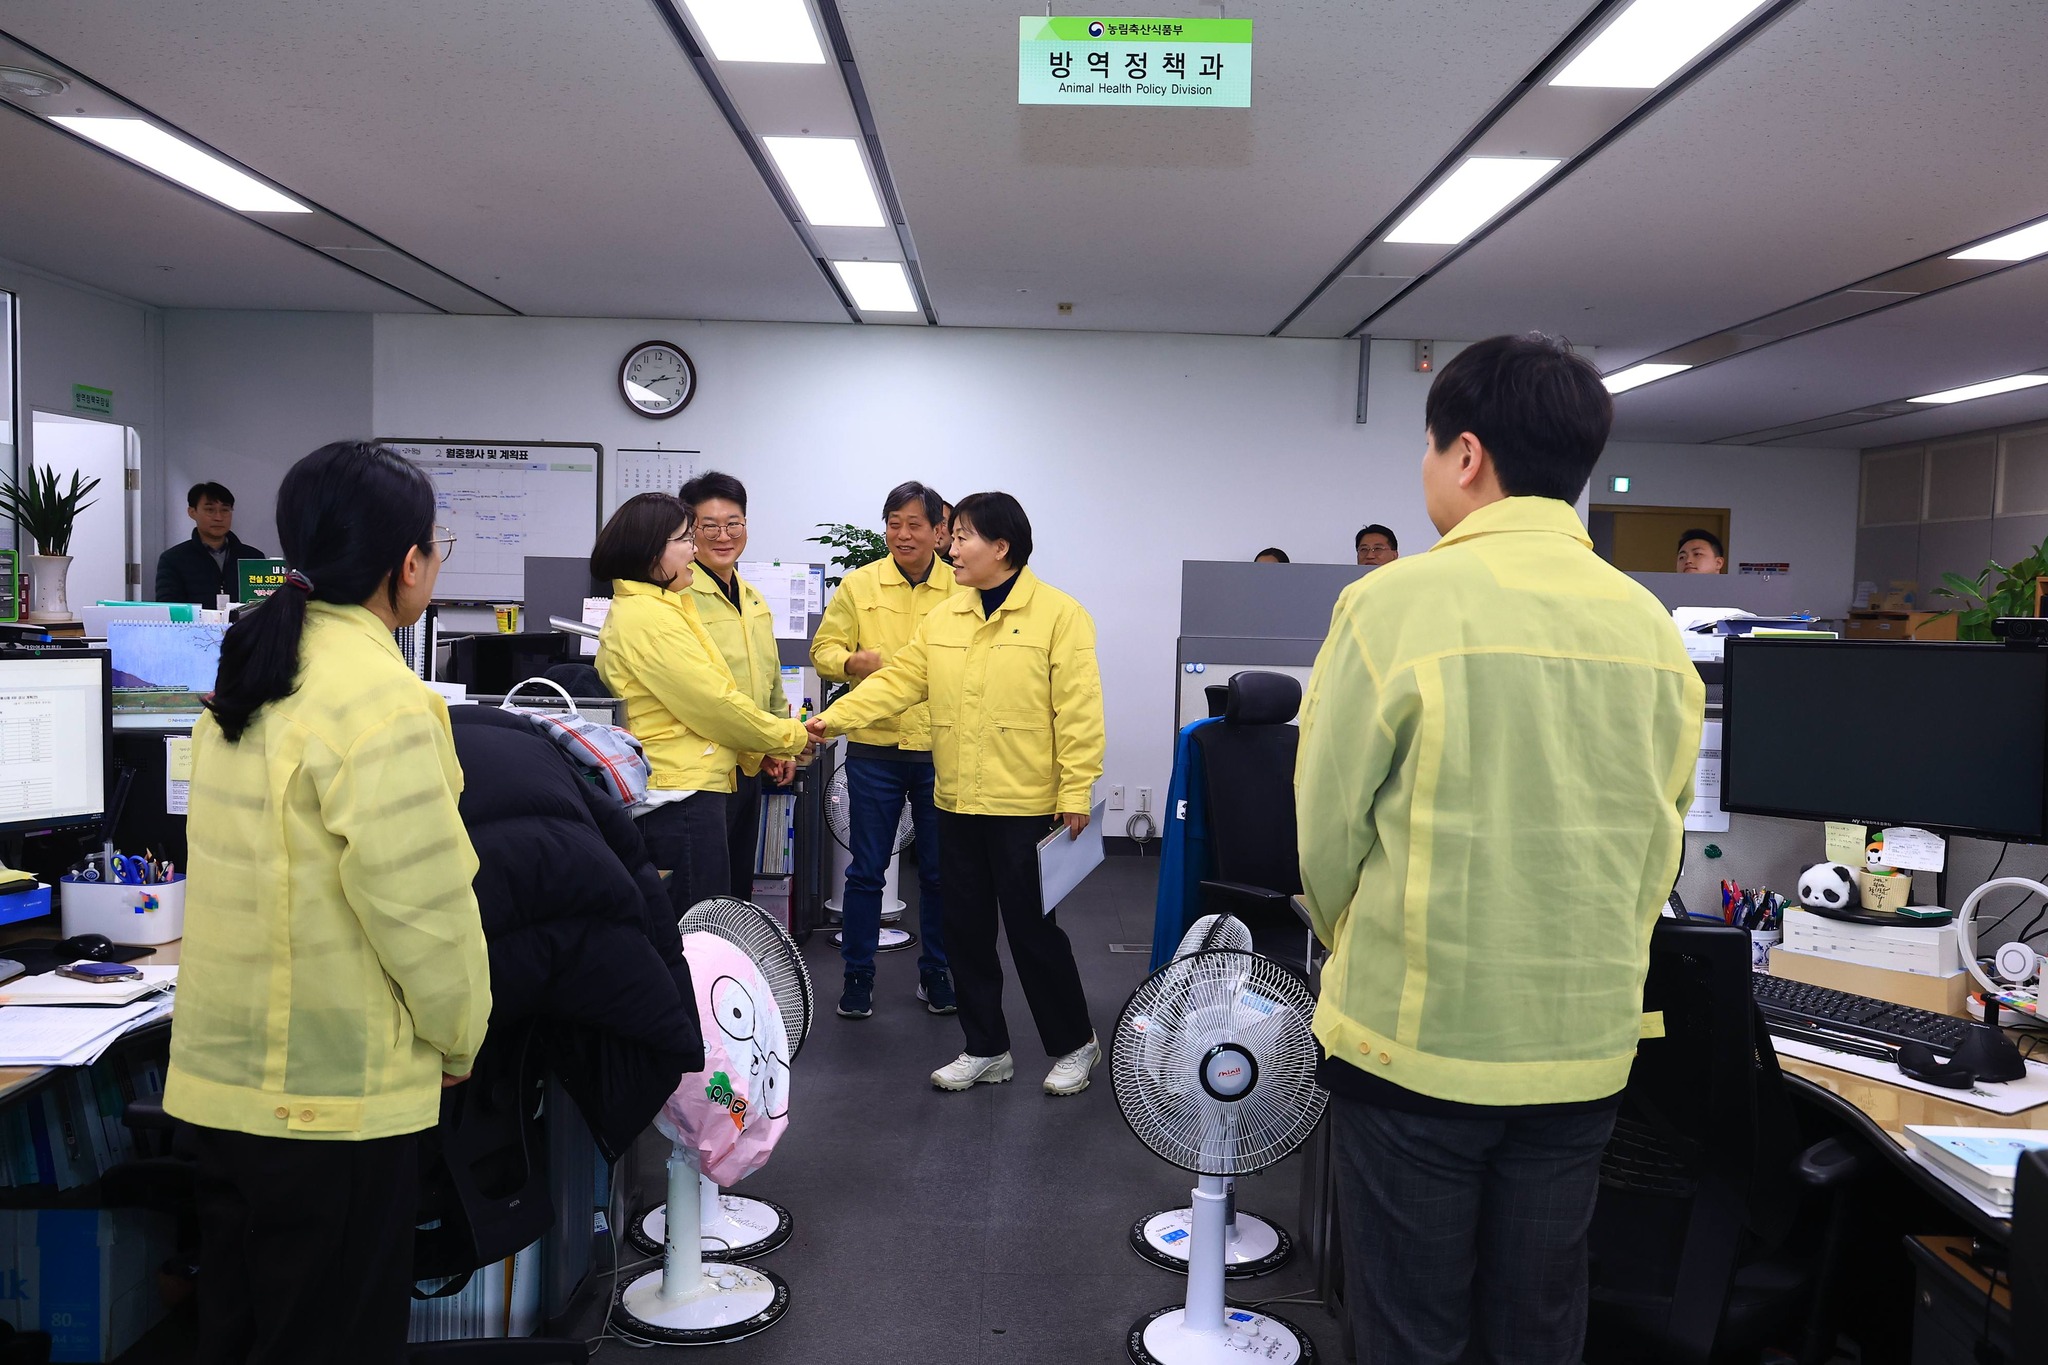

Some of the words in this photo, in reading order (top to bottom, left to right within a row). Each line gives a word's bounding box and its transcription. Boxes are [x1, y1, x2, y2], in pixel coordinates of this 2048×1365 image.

[1107, 23, 1184, 36] 농림축산식품부
[1058, 82, 1094, 93] Animal
[1098, 83, 1131, 94] Health
[1136, 83, 1167, 96] Policy
[1171, 84, 1212, 95] Division
[643, 356, 649, 364] 11
[655, 352, 663, 360] 12
[676, 364, 681, 372] 2
[679, 376, 685, 385] 3
[445, 448, 485, 459] 월중행사
[486, 449, 497, 460] 및
[499, 450, 529, 460] 계획표
[272, 566, 280, 574] 내
[51, 1312, 72, 1327] 80
